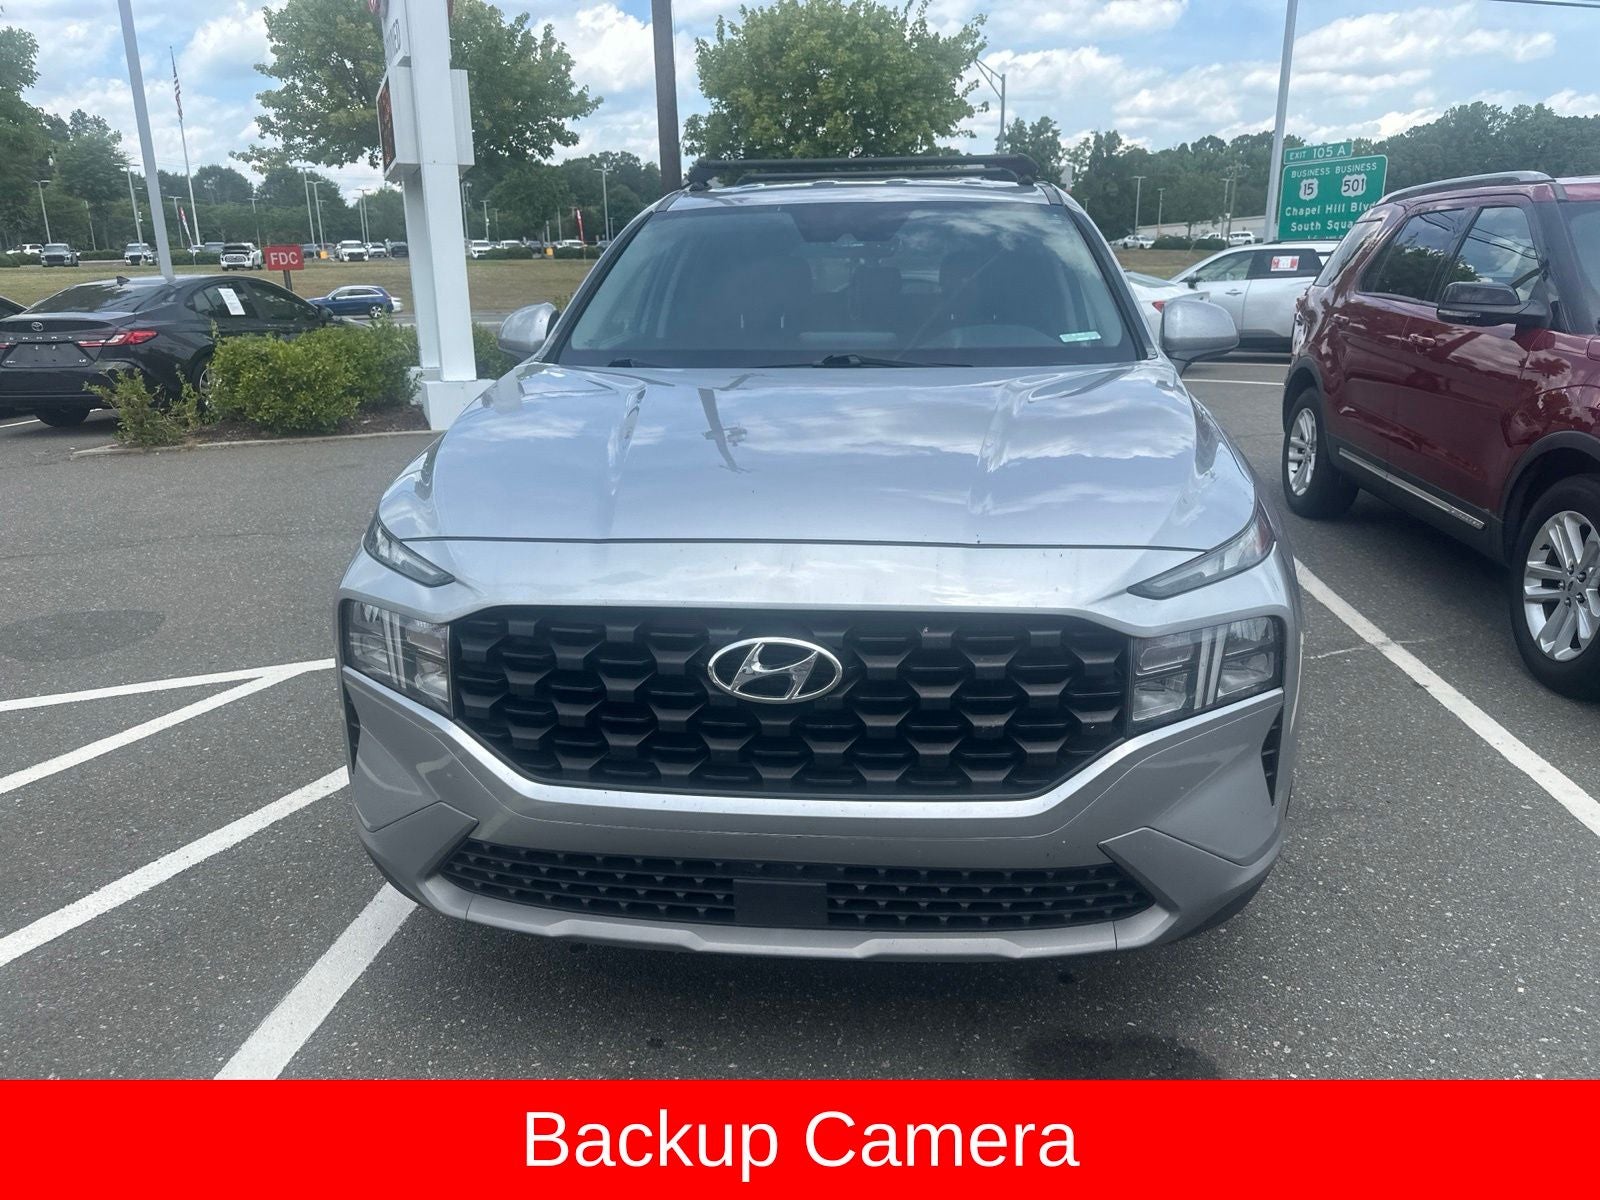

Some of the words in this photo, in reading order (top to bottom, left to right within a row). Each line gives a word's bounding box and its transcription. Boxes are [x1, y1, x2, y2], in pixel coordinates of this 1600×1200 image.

[1289, 151, 1306, 160] EXIT
[1313, 146, 1333, 158] 105
[1337, 146, 1346, 156] A
[1291, 168, 1330, 178] BUSINESS
[1335, 162, 1377, 174] BUSINESS
[1303, 182, 1315, 196] 15
[1343, 179, 1365, 192] 501
[1285, 205, 1321, 217] Chapel
[1325, 203, 1346, 214] Hill
[1290, 221, 1321, 232] South
[1326, 220, 1354, 232] Squa
[270, 251, 299, 266] FDC
